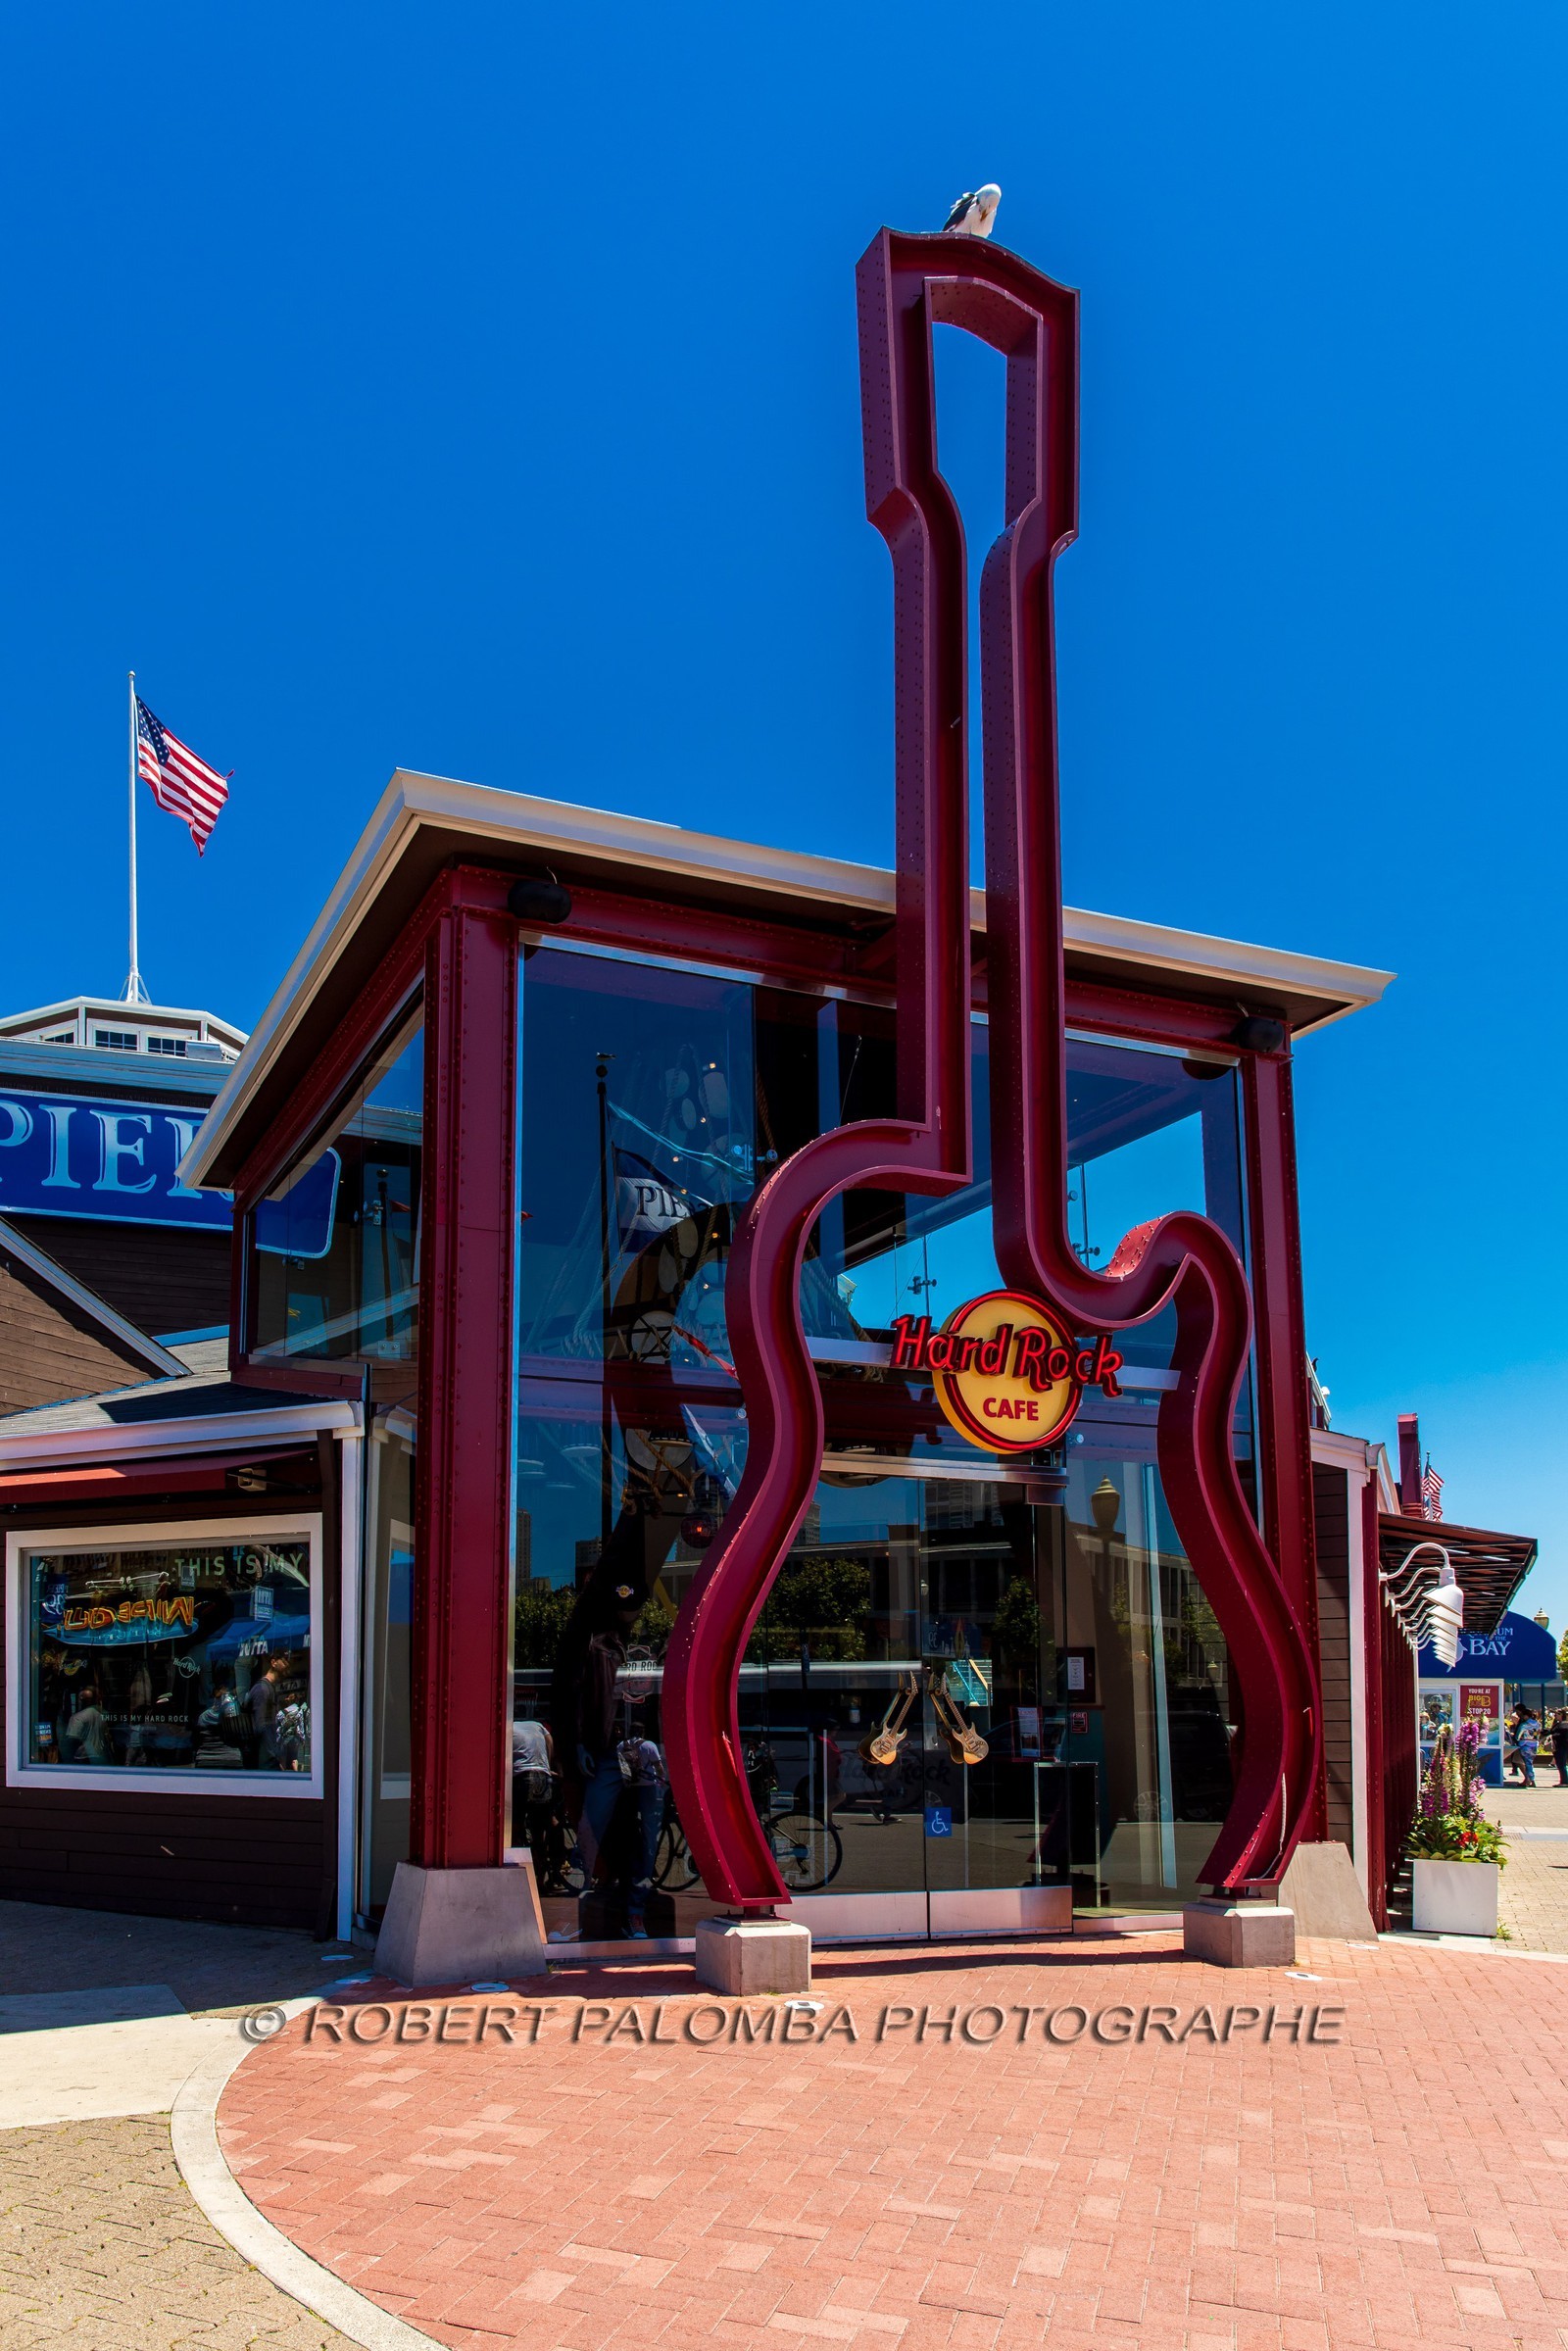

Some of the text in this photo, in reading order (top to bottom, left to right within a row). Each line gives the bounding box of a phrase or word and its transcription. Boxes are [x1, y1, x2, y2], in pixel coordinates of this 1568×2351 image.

[889, 1313, 1124, 1398] Hard Rock
[983, 1397, 1039, 1421] CAFE
[174, 1555, 225, 1577] THIS
[1469, 1639, 1511, 1655] BAY
